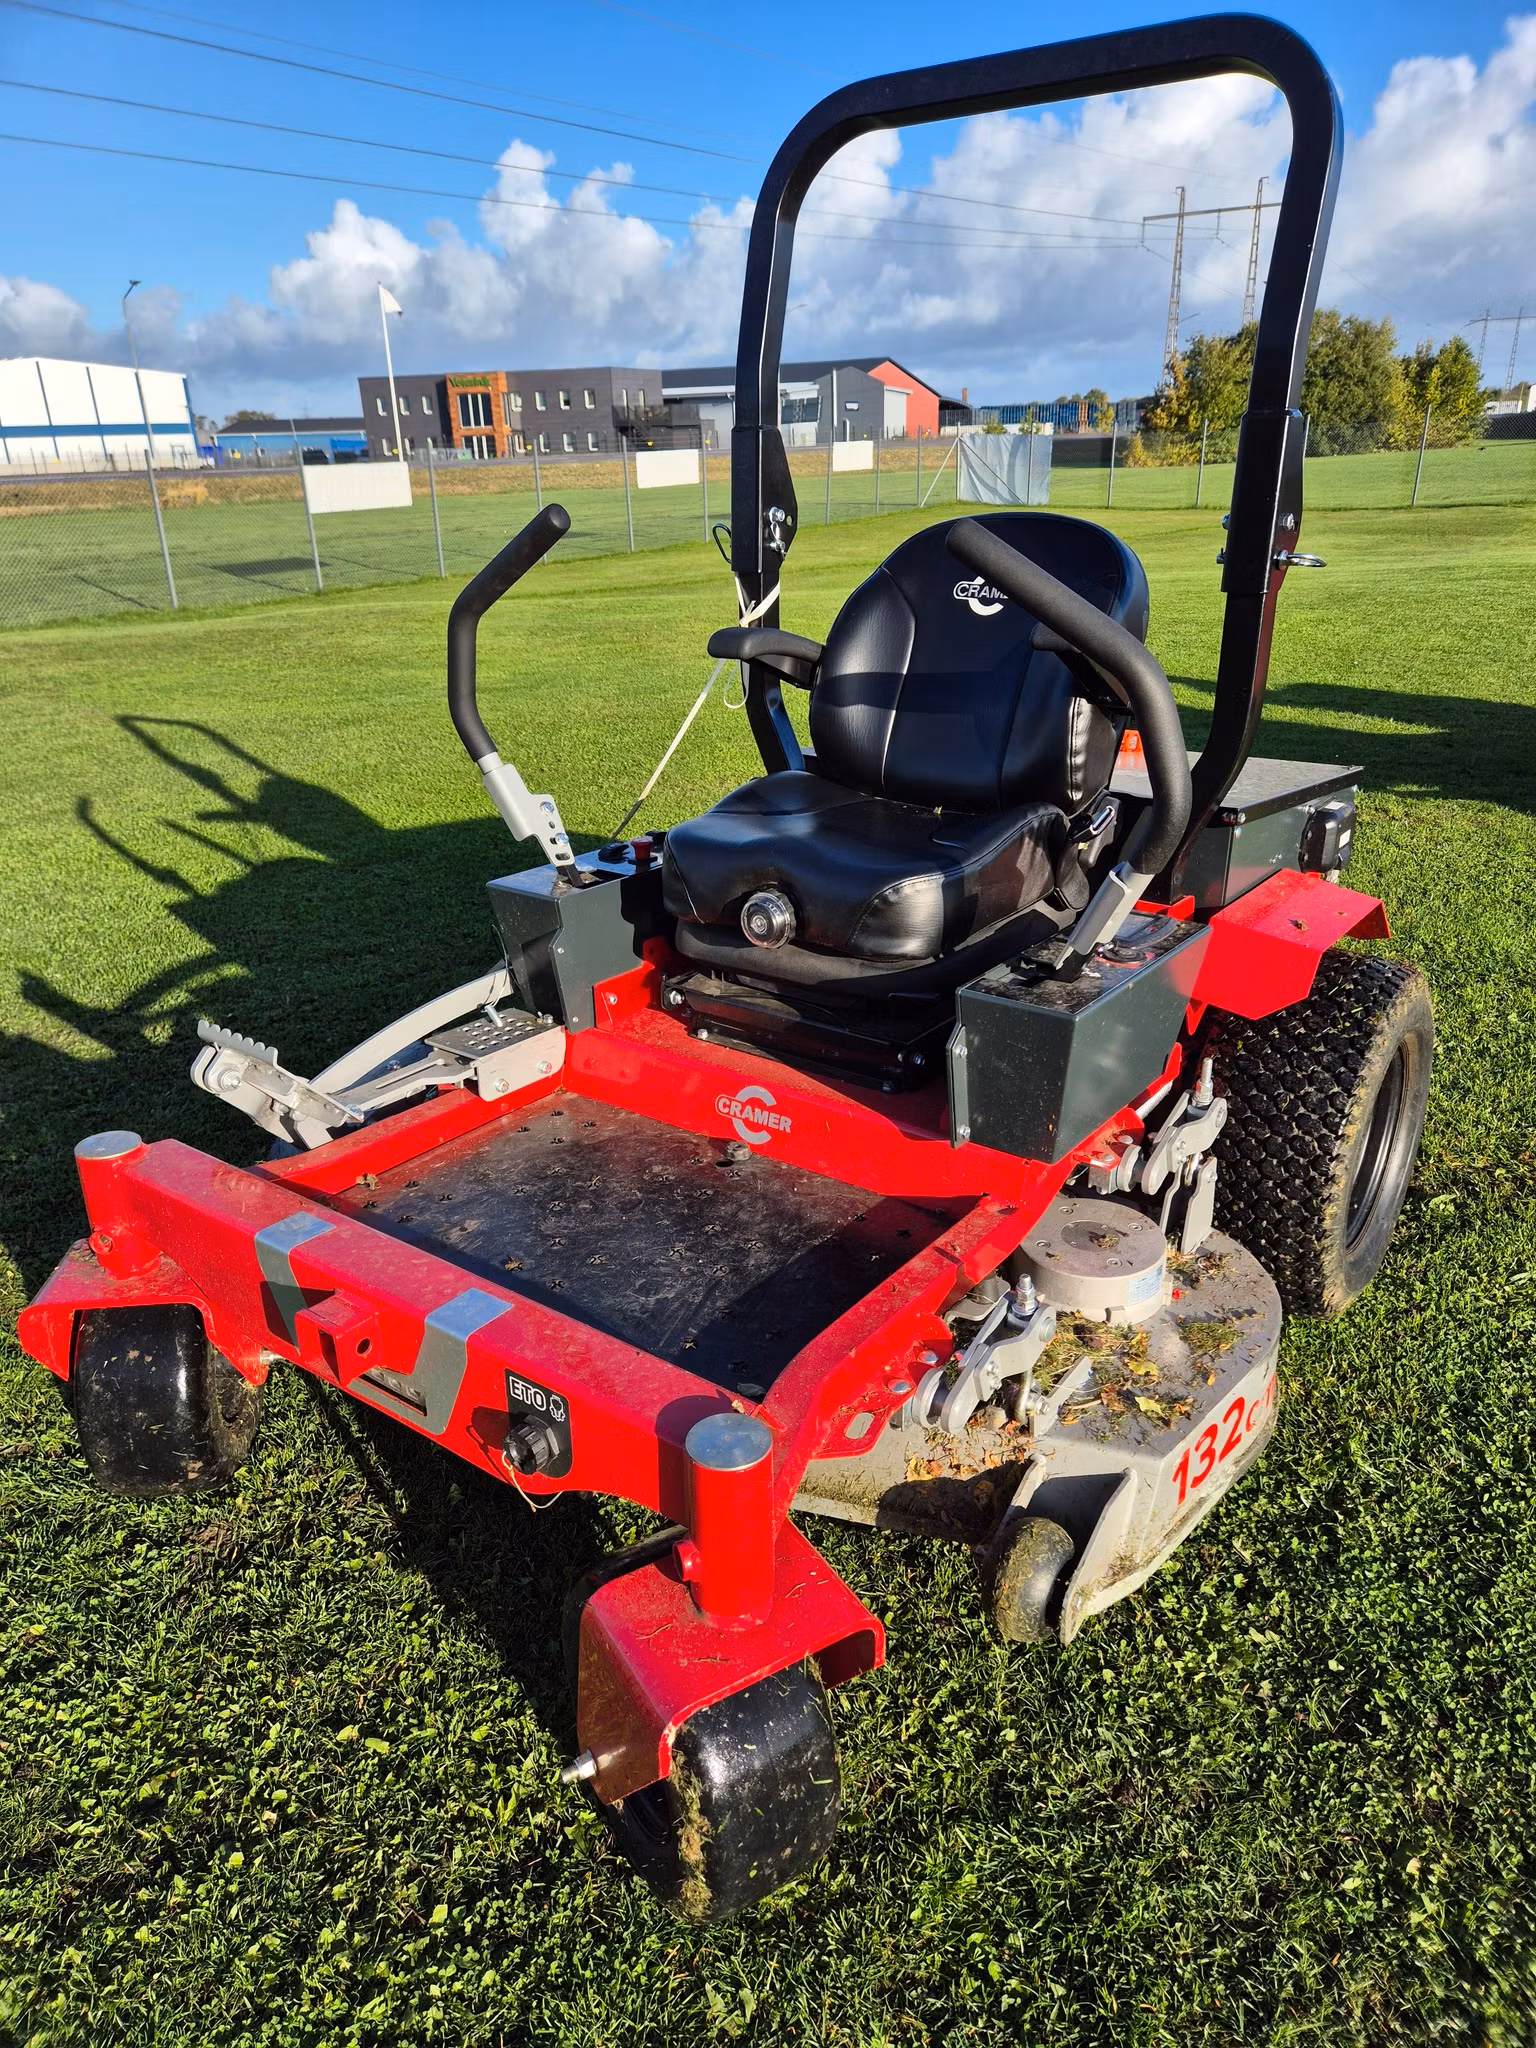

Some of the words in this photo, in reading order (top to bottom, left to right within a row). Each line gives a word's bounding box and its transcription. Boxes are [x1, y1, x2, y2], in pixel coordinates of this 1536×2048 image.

[956, 584, 1009, 599] CRAM
[718, 1097, 792, 1133] CRAMER
[509, 1375, 547, 1411] ETO
